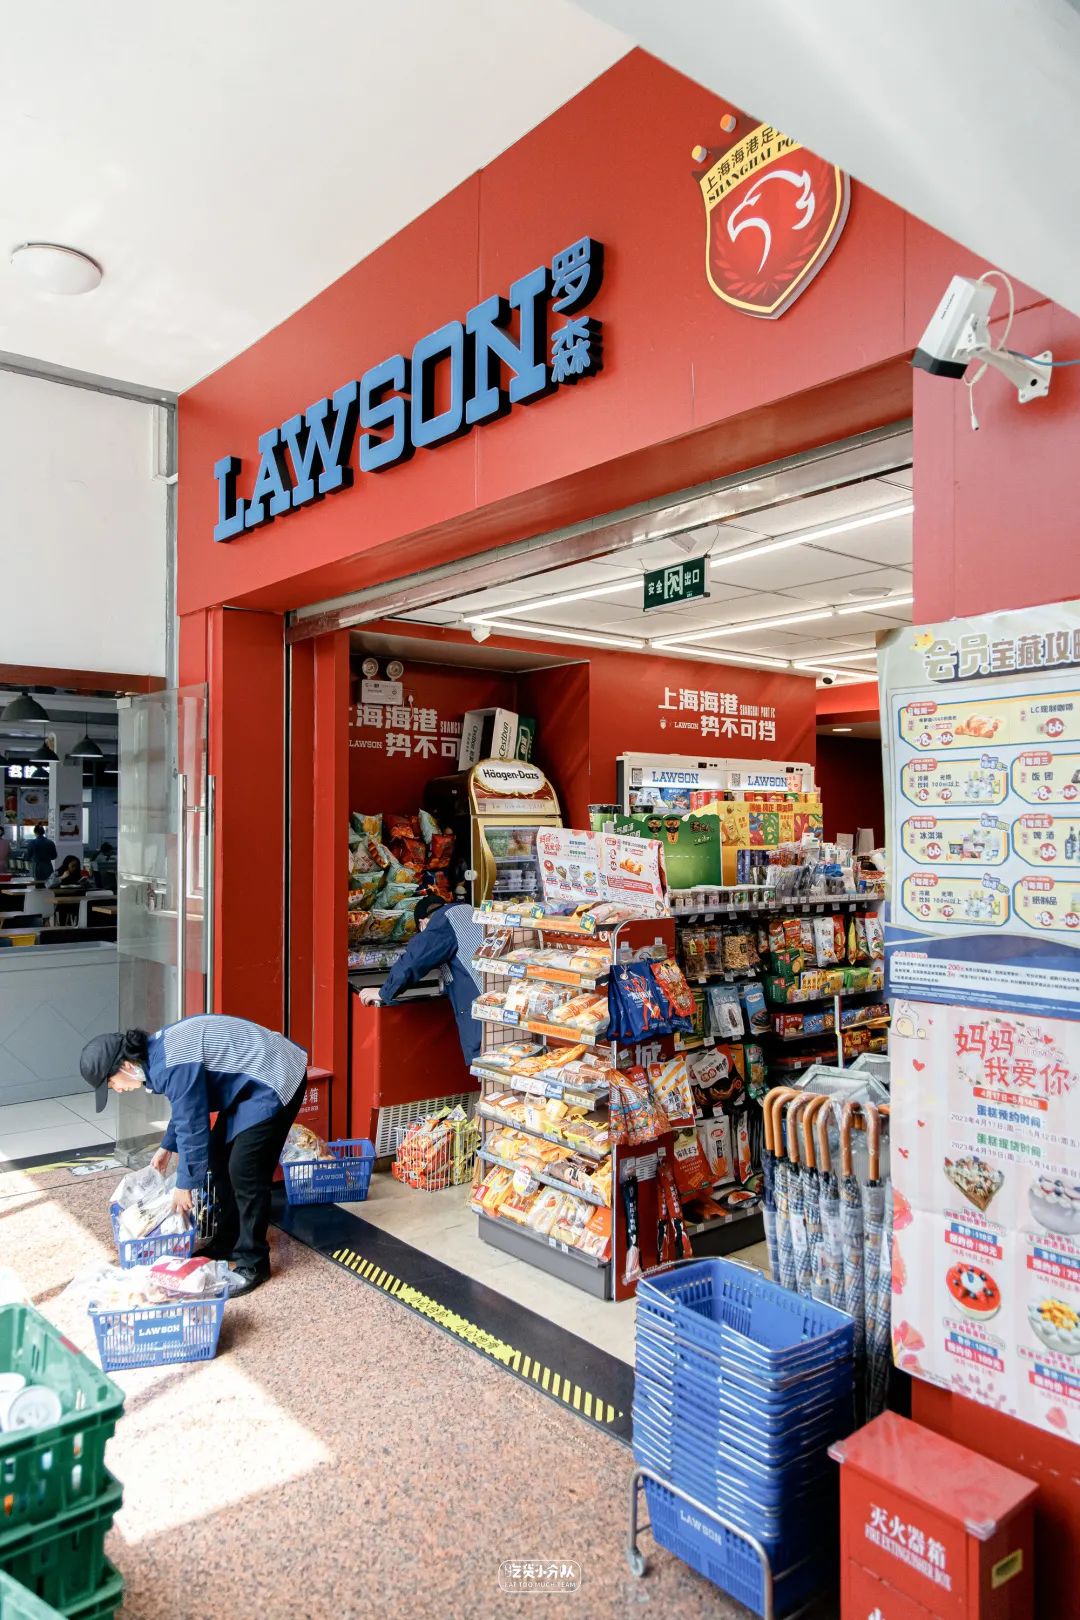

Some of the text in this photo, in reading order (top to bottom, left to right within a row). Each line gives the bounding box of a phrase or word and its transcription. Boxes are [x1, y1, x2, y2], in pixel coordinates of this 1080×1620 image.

[706, 126, 784, 193] 上海海港足
[708, 147, 773, 203] SHANGHAI
[551, 235, 591, 382] 罗森
[214, 265, 549, 543] LAWSON
[648, 569, 700, 596] 安全 出口
[657, 687, 739, 715] 上海海港
[674, 721, 699, 730] LAWSON
[700, 715, 776, 742] 势不可挡
[482, 768, 539, 780] Häagen-Dazs
[652, 771, 699, 784] LAWSON
[747, 775, 788, 787] LAWSON
[954, 1024, 1016, 1060] 妈妈
[984, 1056, 1071, 1096] 我爱你
[315, 1173, 344, 1182] LAWSON
[138, 1324, 181, 1337] LAWSON
[679, 1510, 723, 1547] LAWSON
[869, 1502, 946, 1570] 灭火器箱
